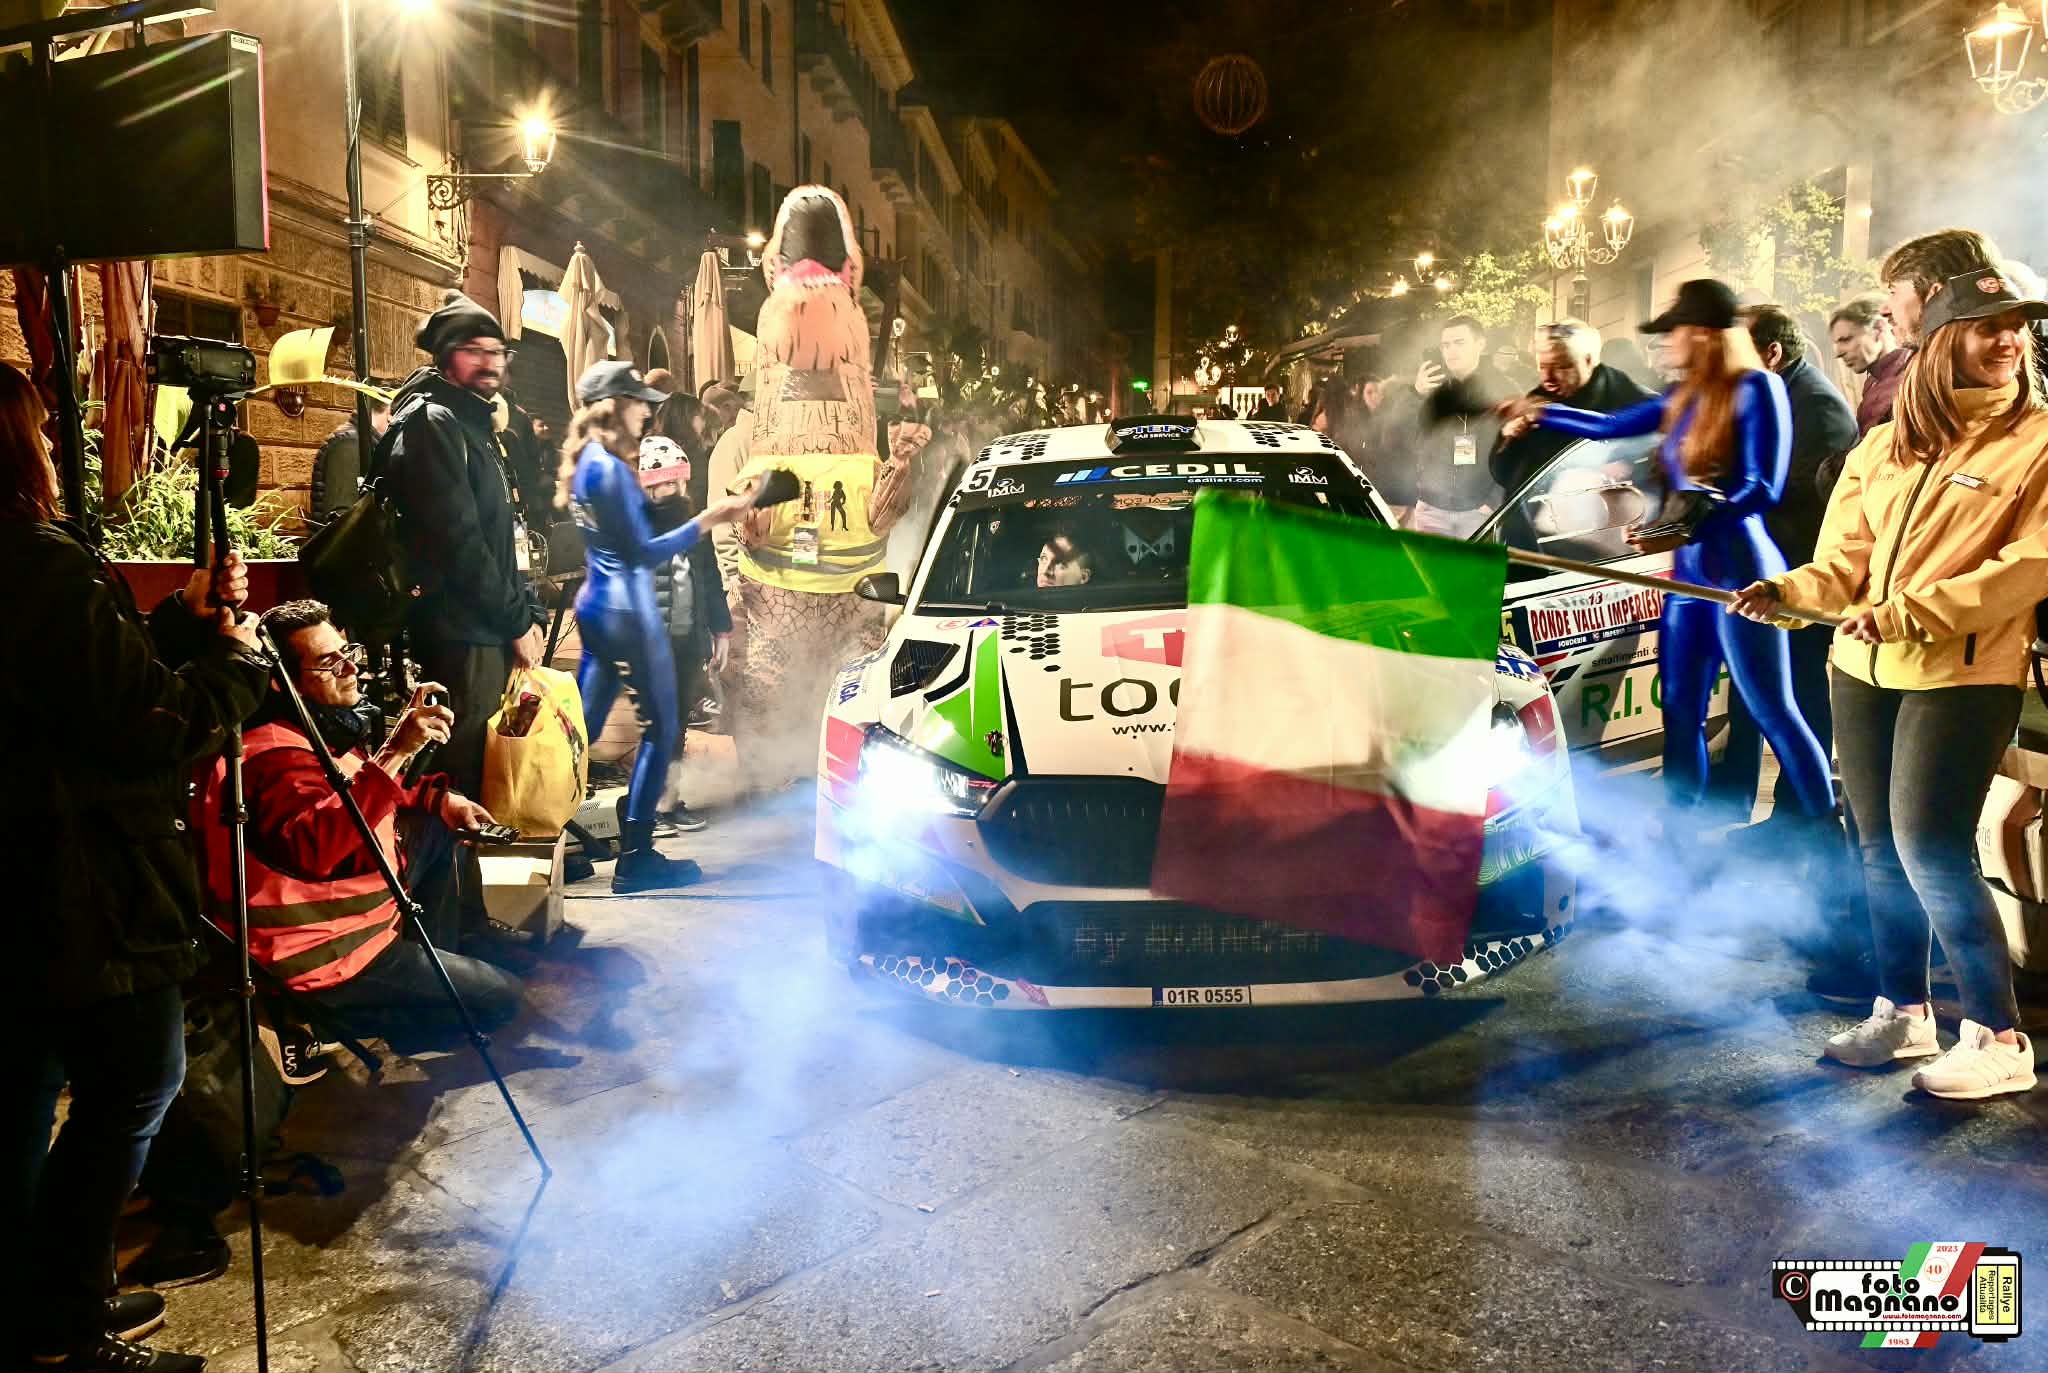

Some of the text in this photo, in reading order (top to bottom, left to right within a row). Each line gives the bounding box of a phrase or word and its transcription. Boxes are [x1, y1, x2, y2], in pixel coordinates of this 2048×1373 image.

[1115, 424, 1196, 437] STEFY
[1111, 463, 1261, 478] CEDIL
[968, 469, 993, 492] 5
[1530, 609, 1572, 642] RONDE
[1573, 606, 1606, 633] VALLI
[1112, 721, 1176, 735] www.
[1167, 989, 1200, 1004] 01R
[1205, 988, 1243, 1003] 0555
